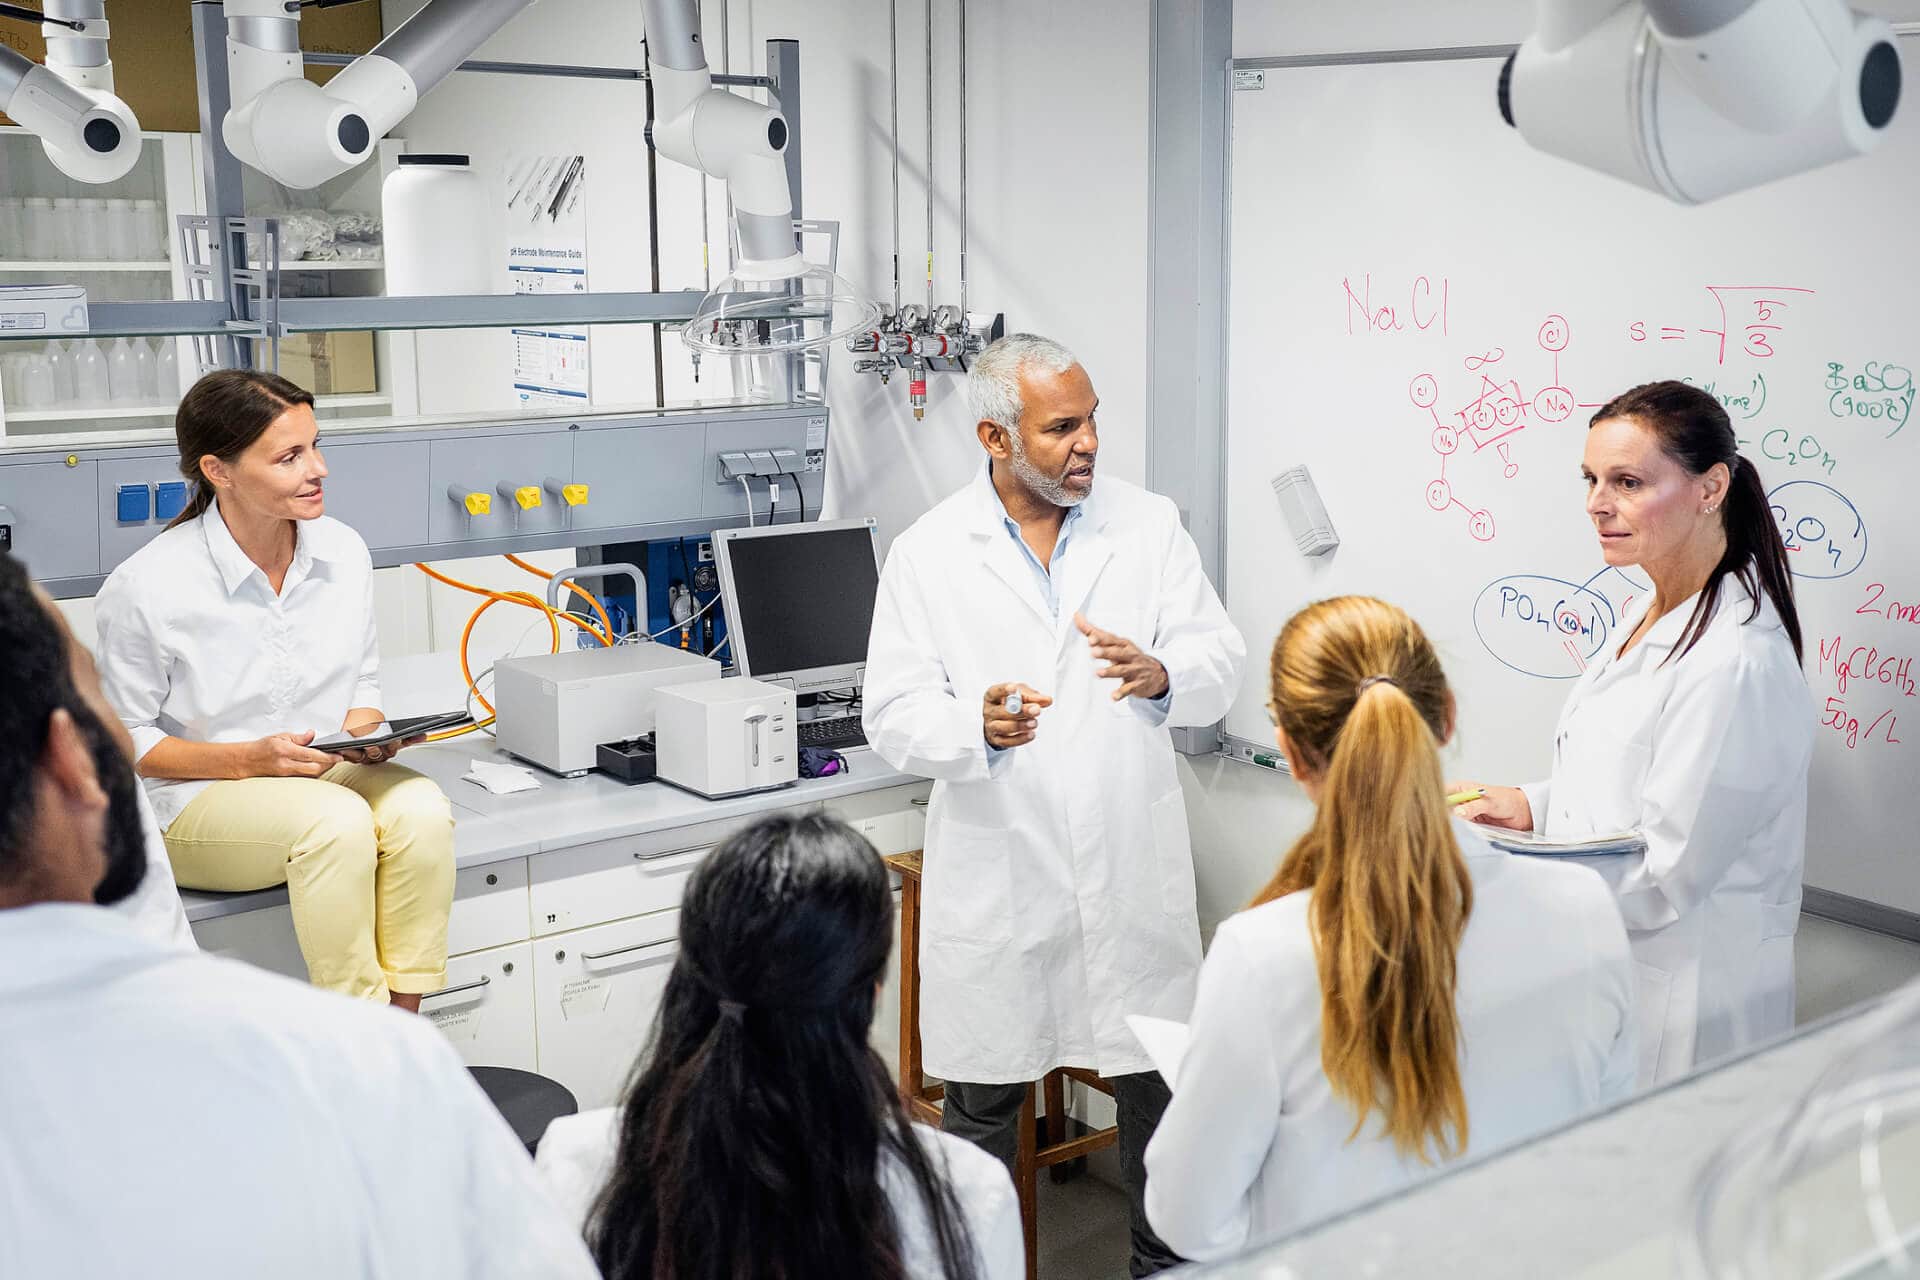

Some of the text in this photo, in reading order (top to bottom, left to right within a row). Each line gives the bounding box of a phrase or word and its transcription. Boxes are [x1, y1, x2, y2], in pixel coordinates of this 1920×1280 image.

[518, 247, 538, 257] Electrode
[538, 248, 567, 259] Maintenance
[568, 249, 582, 259] Guide
[1343, 273, 1447, 336] NaCl
[1546, 395, 1569, 413] Na
[1856, 583, 1884, 615] 2
